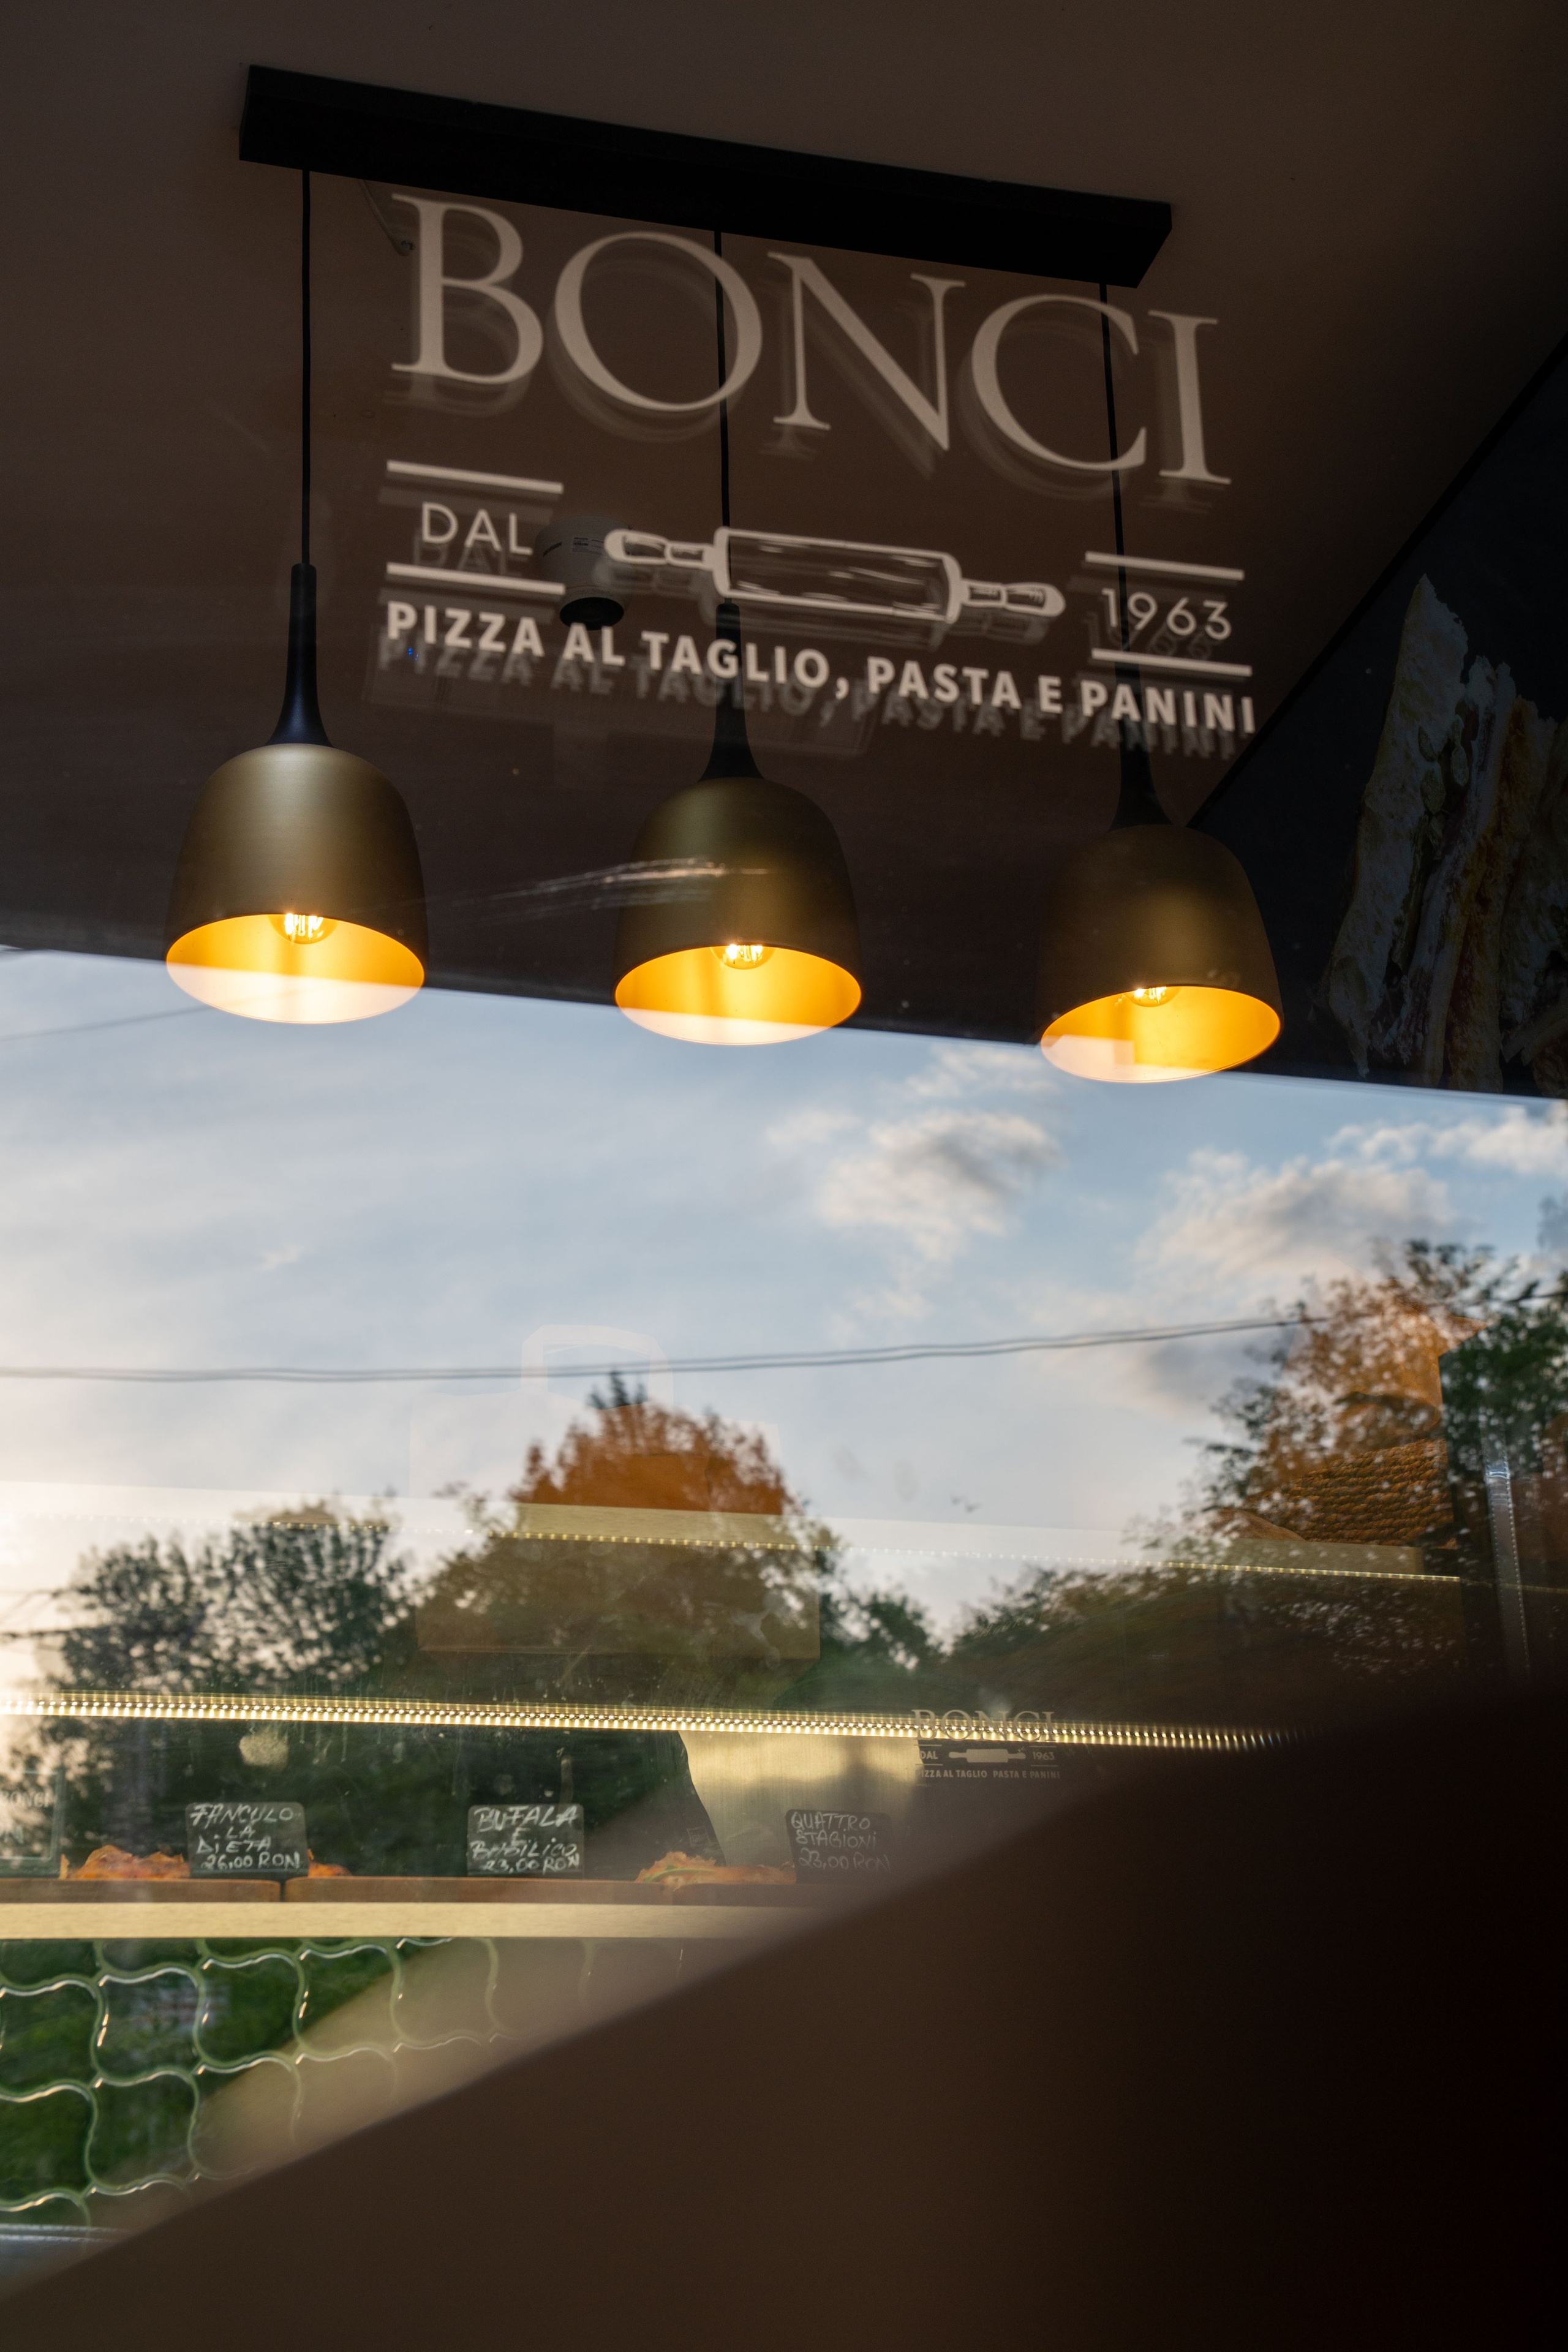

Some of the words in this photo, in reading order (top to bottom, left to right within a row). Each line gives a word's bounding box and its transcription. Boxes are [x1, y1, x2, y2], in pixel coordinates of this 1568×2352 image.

[391, 193, 1232, 485] BONCI
[422, 502, 533, 556] DAL
[1102, 588, 1232, 641] 1963
[388, 601, 545, 657] PIZZA
[564, 622, 625, 666] AL
[641, 631, 849, 699] TAGLIO,
[867, 656, 1022, 710] PASTA
[1038, 676, 1063, 714] E
[1081, 679, 1255, 734] PANINI
[911, 1709, 1057, 1742] BONCI
[921, 1751, 938, 1760] DAL
[1032, 1752, 1055, 1760] 1963
[918, 1770, 941, 1778] IZZA
[943, 1770, 954, 1778] AL
[190, 1803, 293, 1830] FANCULO
[473, 1805, 579, 1833] BUFALA
[791, 1811, 870, 1830] QUATTRO
[225, 1825, 256, 1839] LA
[511, 1826, 530, 1846] E
[258, 1850, 300, 1871] RON
[542, 1853, 580, 1875] RON
[853, 1851, 891, 1873] RON
